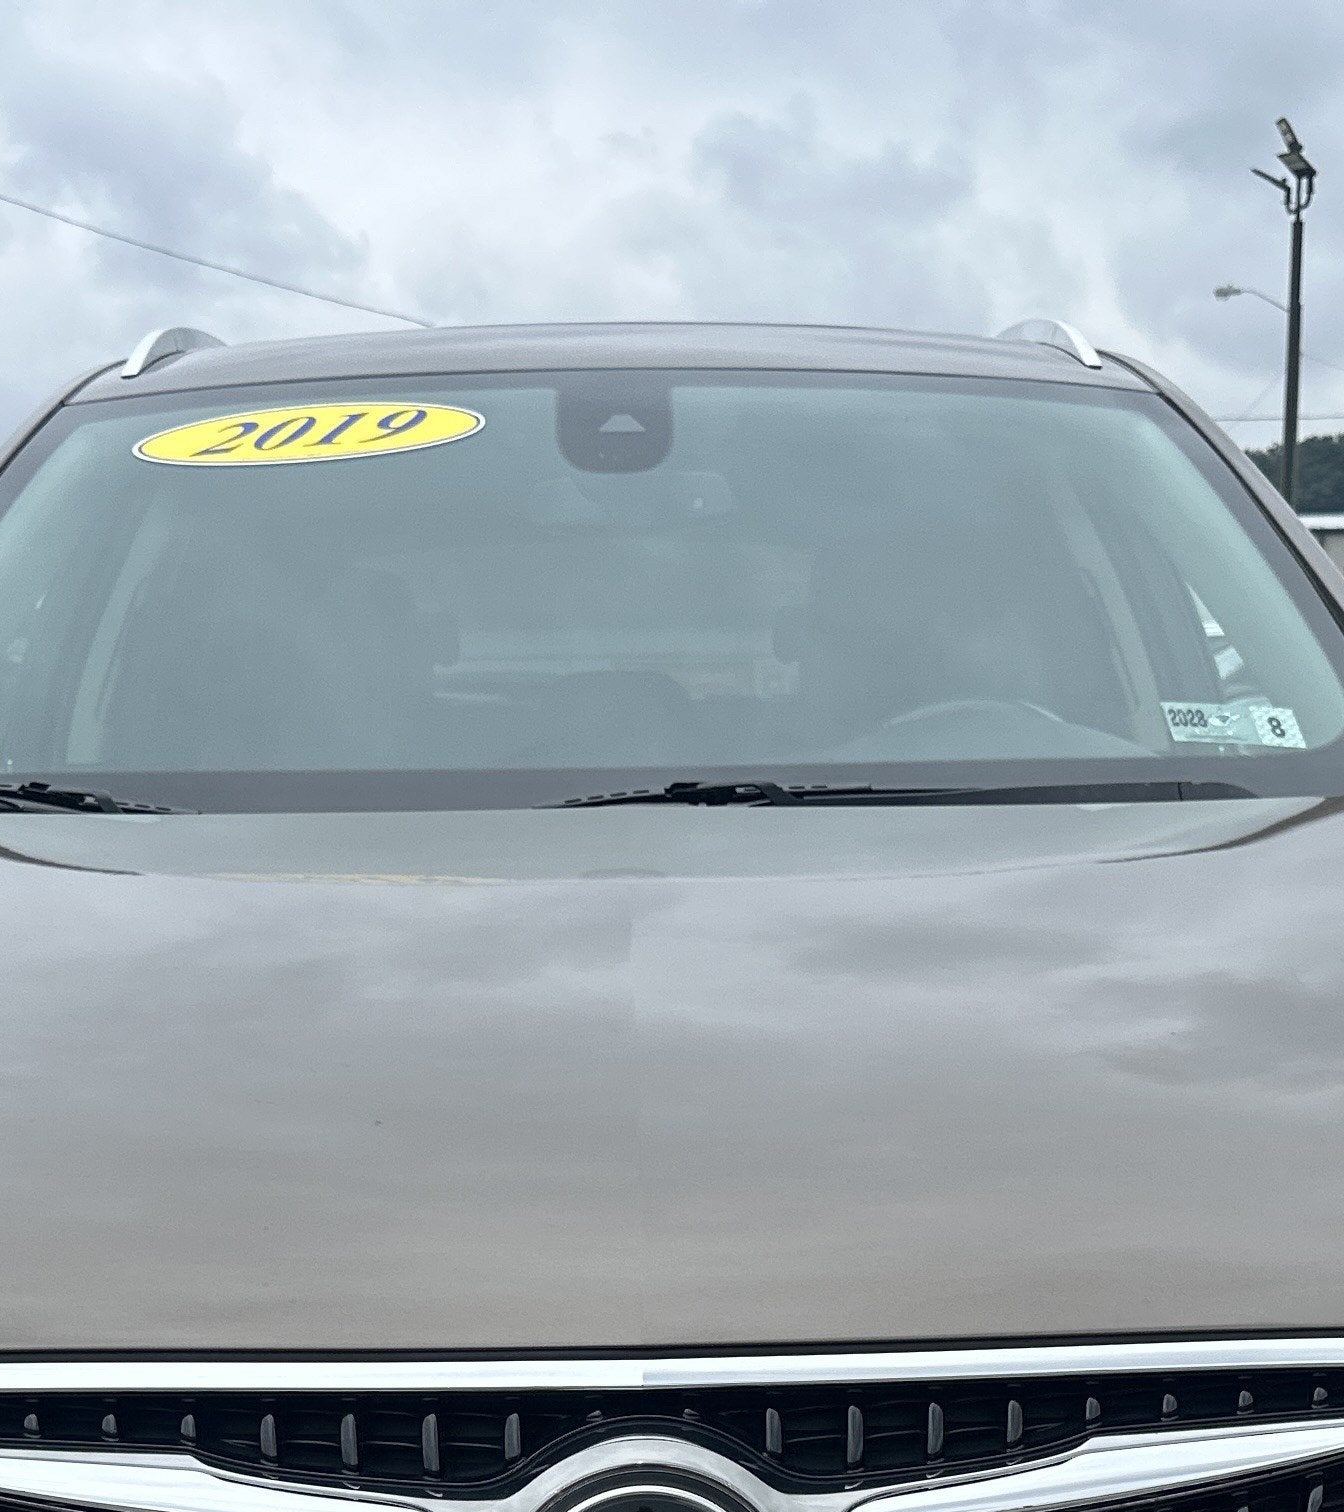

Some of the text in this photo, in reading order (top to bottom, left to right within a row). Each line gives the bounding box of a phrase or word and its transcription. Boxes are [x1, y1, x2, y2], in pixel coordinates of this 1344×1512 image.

[189, 410, 427, 457] 2019
[1167, 708, 1208, 728] 2028
[1267, 716, 1286, 738] 8
